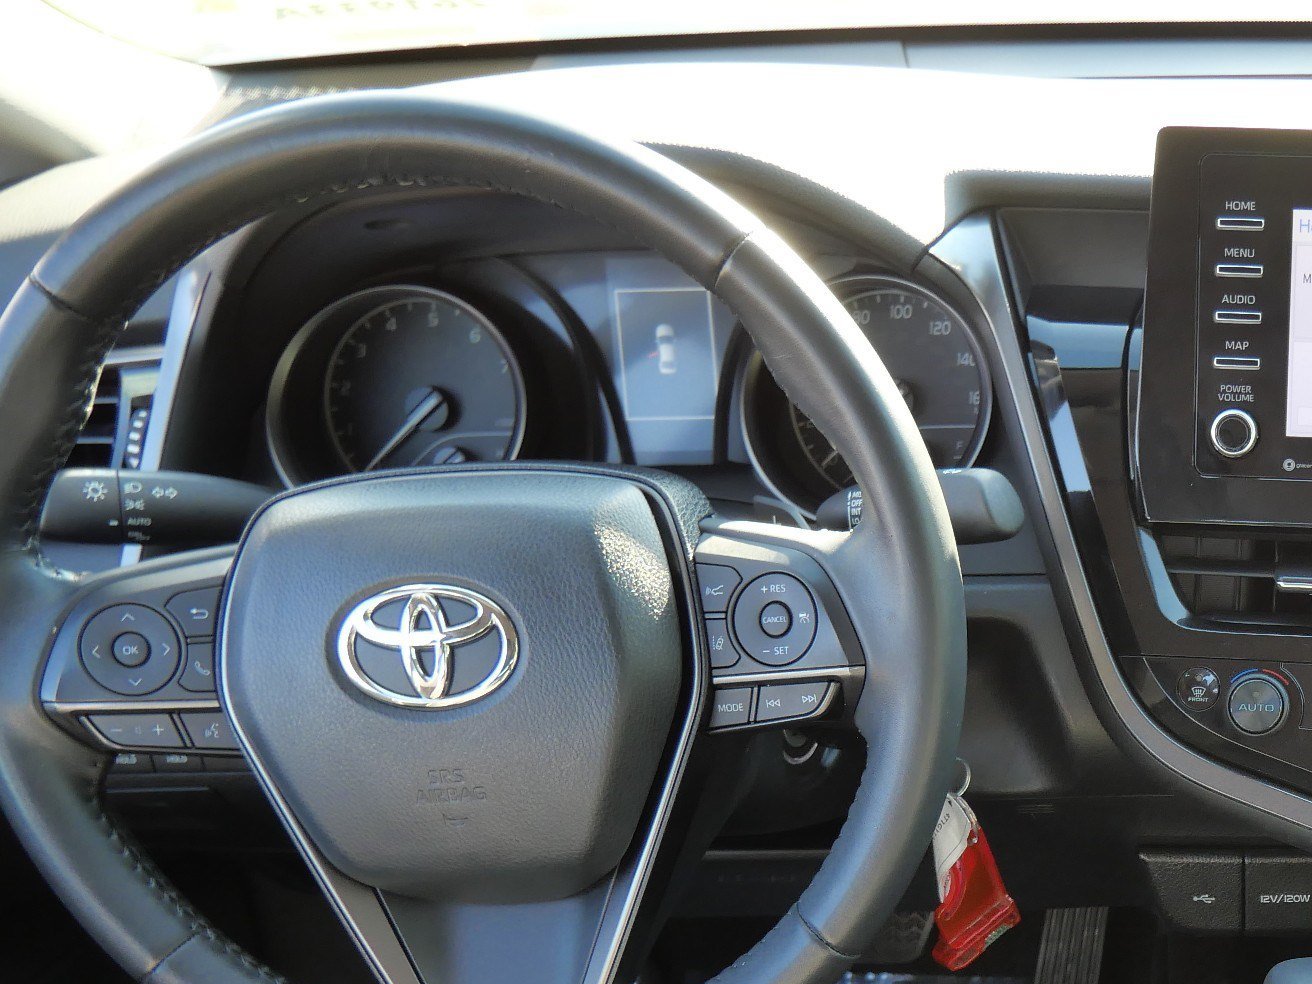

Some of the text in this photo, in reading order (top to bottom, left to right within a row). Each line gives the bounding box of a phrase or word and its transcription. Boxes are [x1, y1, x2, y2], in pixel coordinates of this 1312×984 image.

[1225, 201, 1256, 211] HOME
[1224, 248, 1255, 258] MENU
[1221, 294, 1256, 305] AUDIO
[890, 304, 913, 320] 100
[929, 320, 952, 336] 120
[1225, 340, 1250, 351] MAP
[1220, 384, 1252, 393] POWER
[1217, 393, 1255, 402] VOLUME
[770, 584, 786, 593] RES
[762, 616, 787, 624] CANCEL
[122, 645, 139, 656] OK
[774, 646, 789, 656] SET
[718, 703, 744, 713] MODE
[1238, 703, 1275, 713] AUTO
[427, 769, 464, 783] SRS
[1259, 894, 1312, 904] 12V/120W
